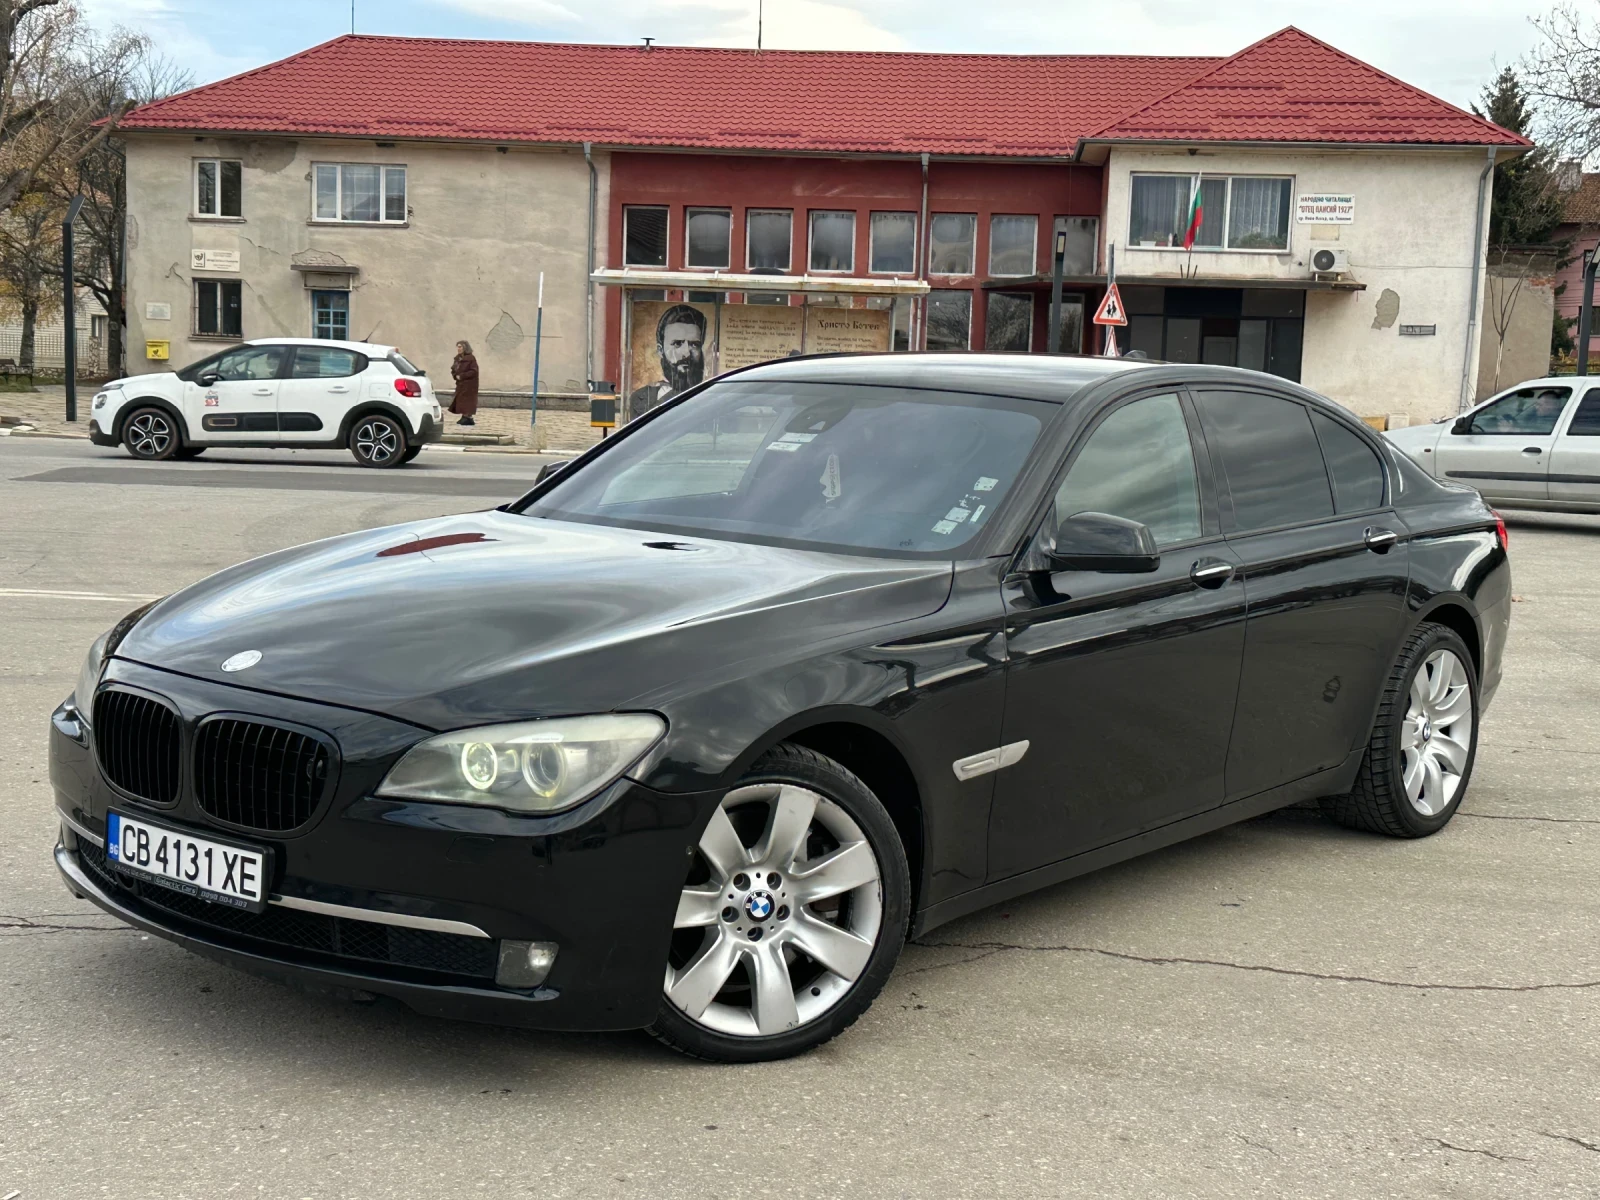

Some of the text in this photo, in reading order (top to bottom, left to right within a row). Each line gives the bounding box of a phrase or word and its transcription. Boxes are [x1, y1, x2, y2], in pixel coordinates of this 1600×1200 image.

[817, 320, 851, 330] Христо
[155, 876, 197, 894] Galactic Cars
